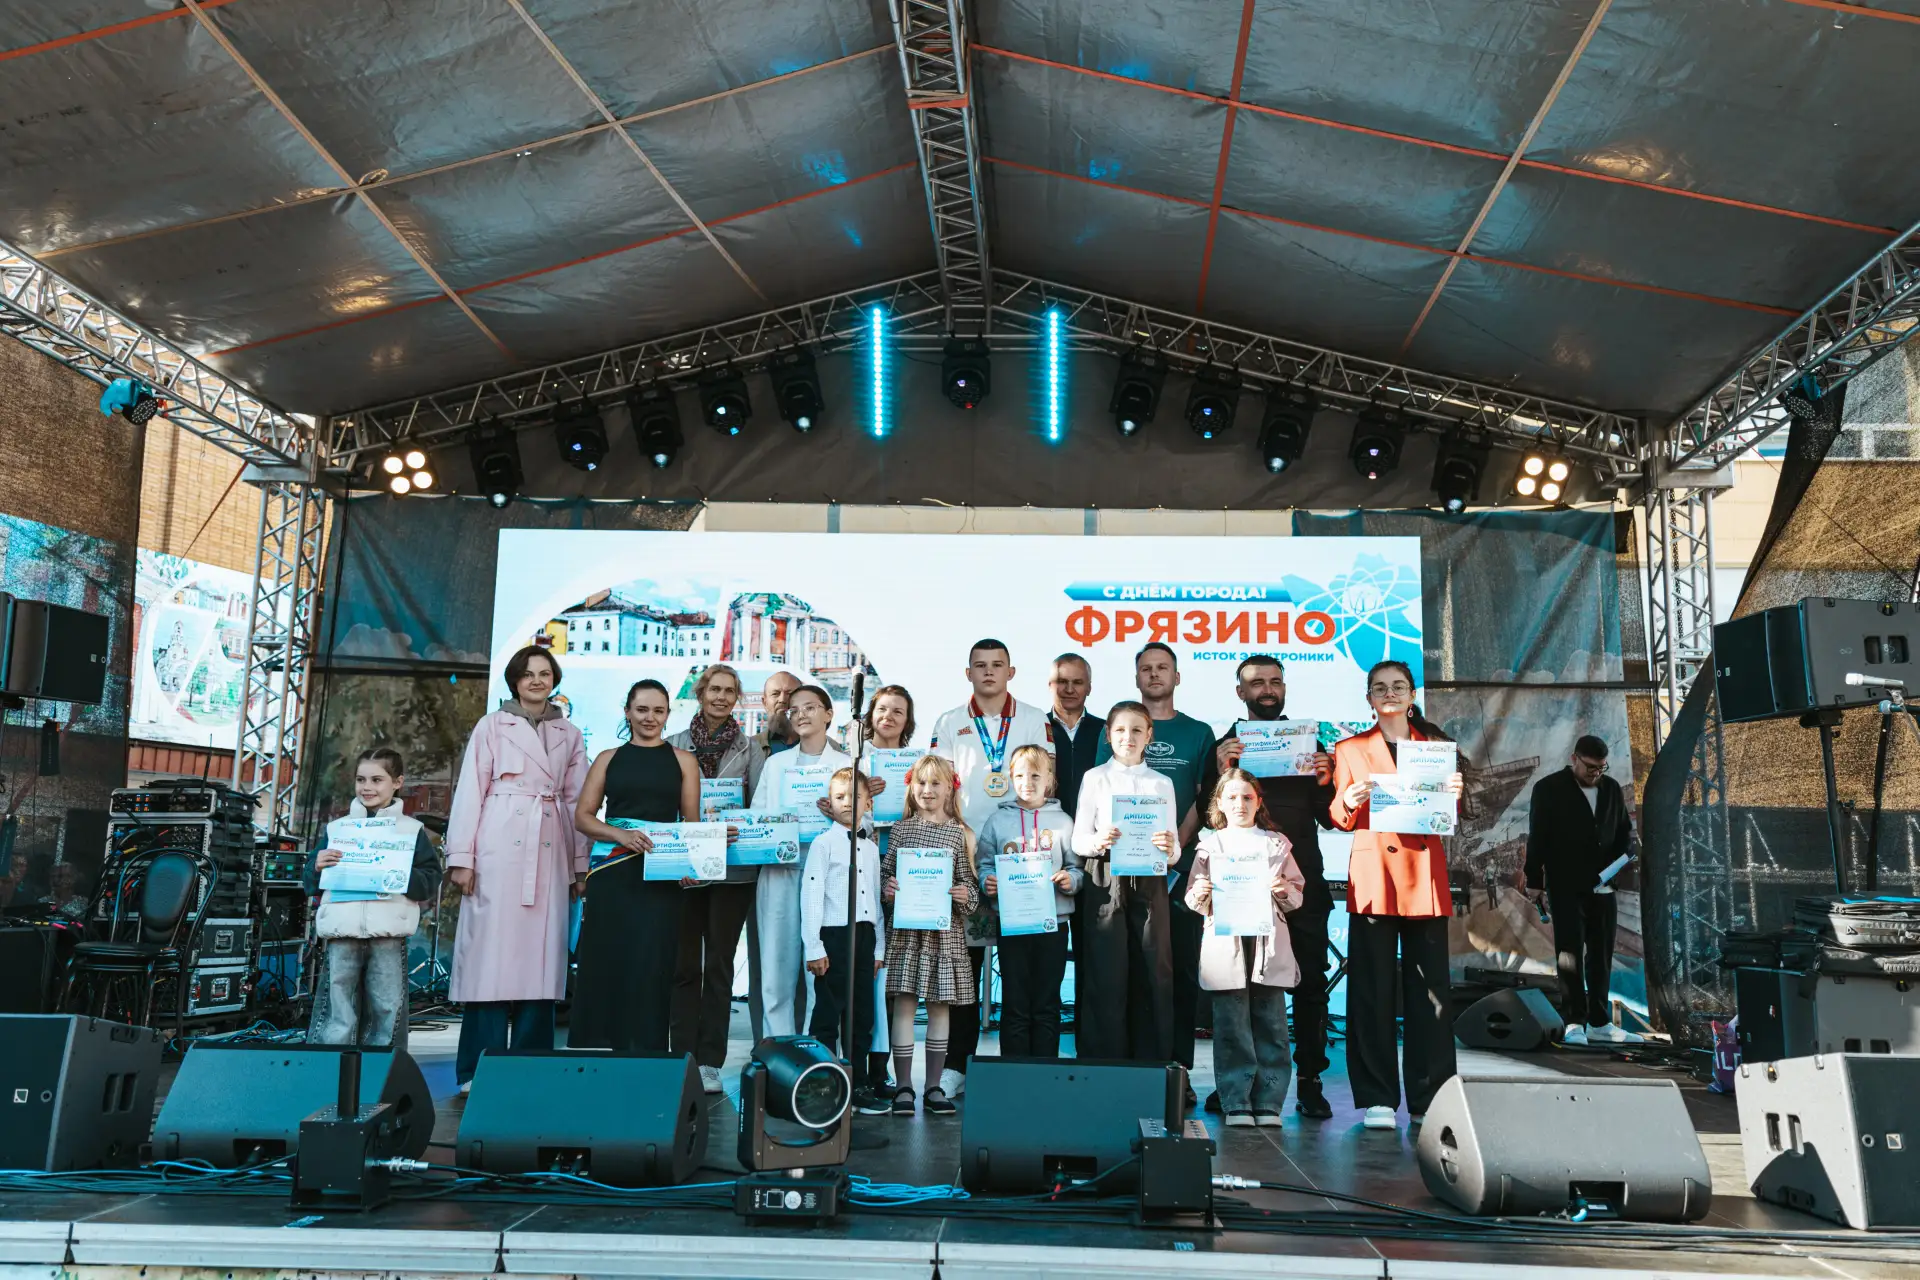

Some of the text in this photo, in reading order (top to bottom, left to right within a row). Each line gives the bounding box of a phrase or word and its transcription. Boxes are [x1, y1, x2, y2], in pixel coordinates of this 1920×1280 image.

[1102, 585, 1267, 600] С ДНЁМ ГОРОДА!
[1065, 605, 1336, 647] ФРЯЗИНО
[1193, 651, 1237, 661] ИСТОК
[1245, 740, 1279, 748] ЕРТИФИКАТ
[703, 791, 735, 799] ДИПЛОМ
[1123, 812, 1158, 820] ДИПЛОМ
[908, 867, 944, 875] ДИПЛОМ
[1008, 871, 1044, 881] ДИПЛОМ
